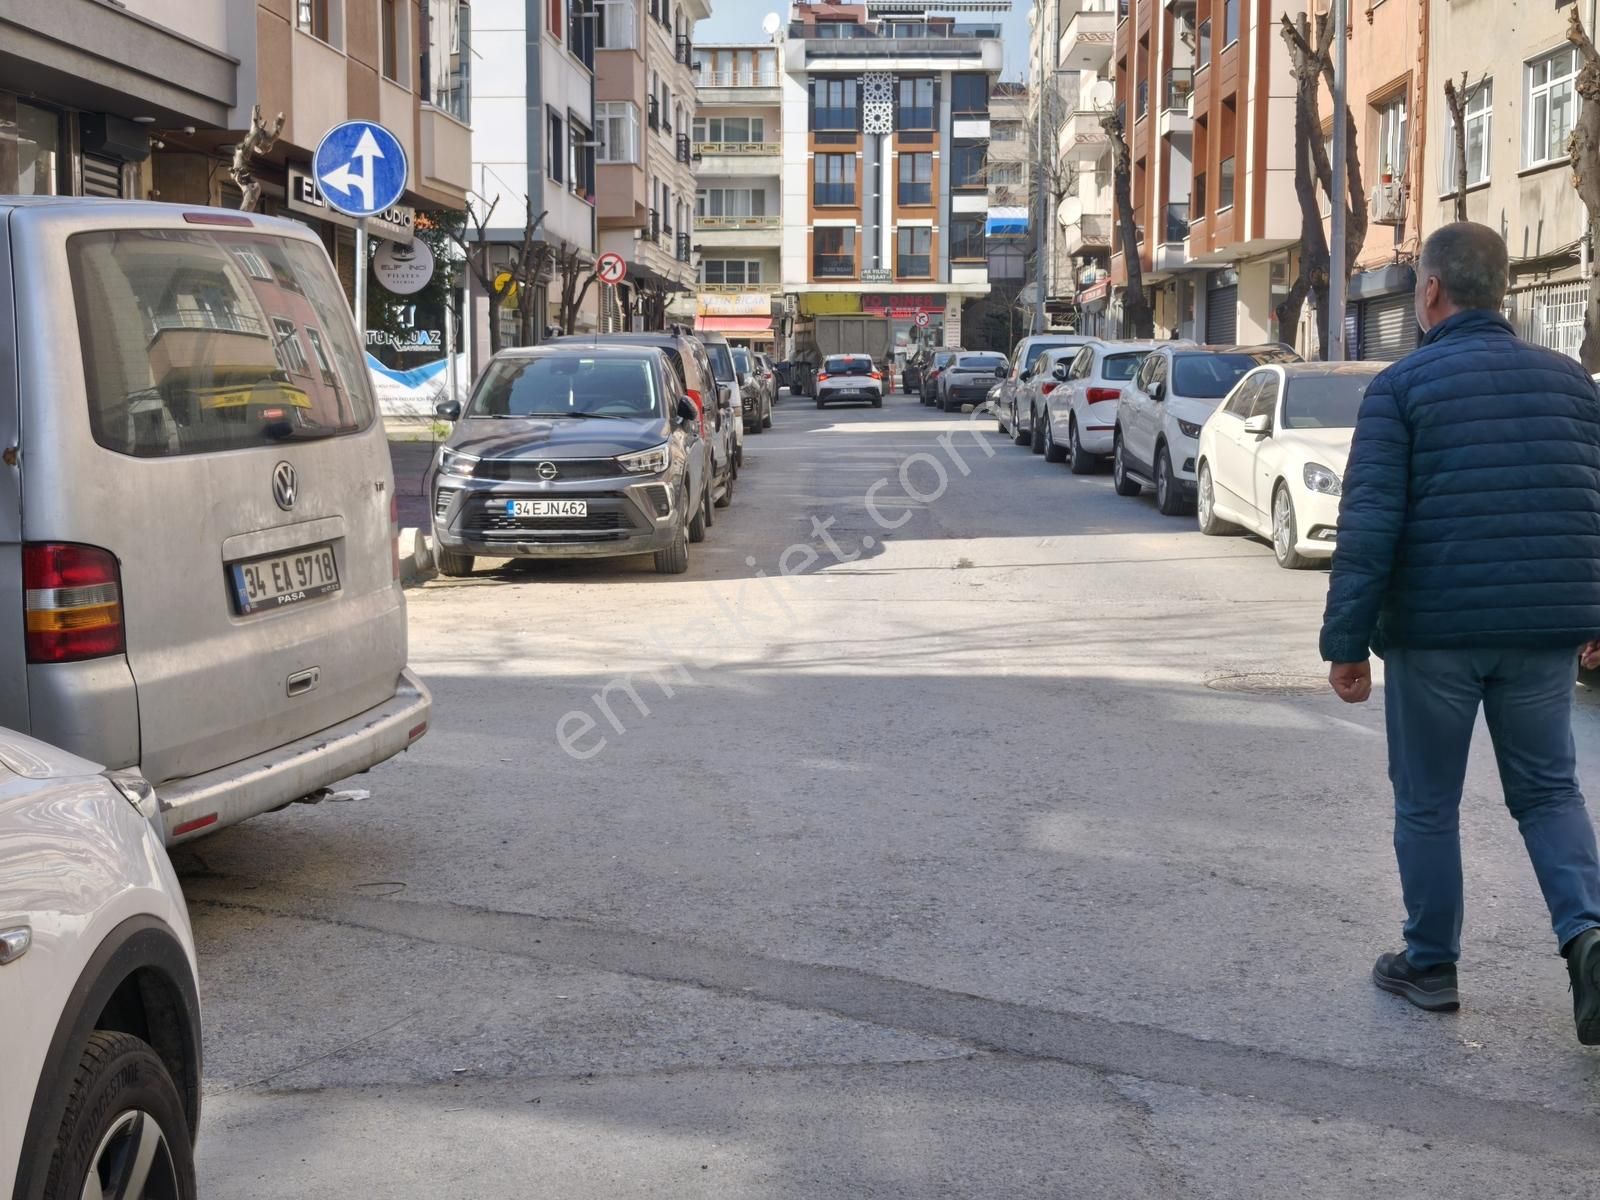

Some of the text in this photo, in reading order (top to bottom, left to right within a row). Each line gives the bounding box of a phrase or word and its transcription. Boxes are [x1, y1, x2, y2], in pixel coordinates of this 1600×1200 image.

[515, 502, 530, 515] 34
[244, 552, 334, 598] 34 EA 9718
[277, 591, 306, 604] PASA
